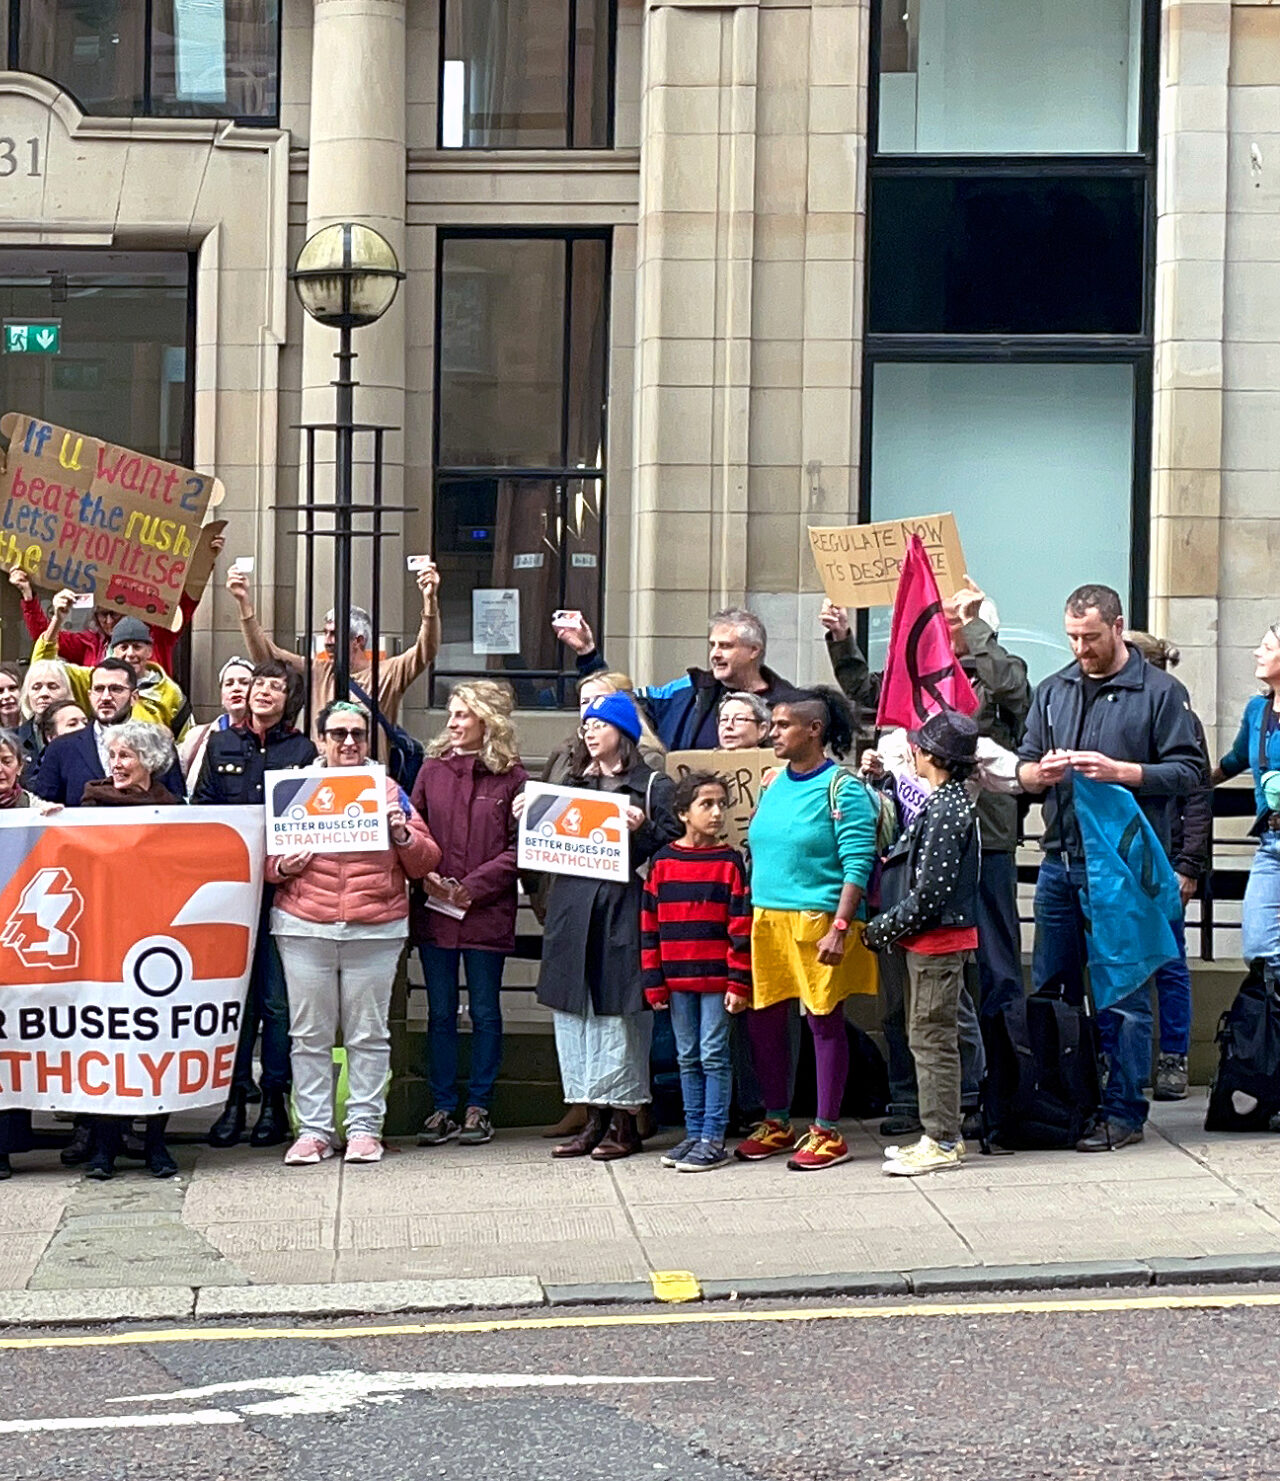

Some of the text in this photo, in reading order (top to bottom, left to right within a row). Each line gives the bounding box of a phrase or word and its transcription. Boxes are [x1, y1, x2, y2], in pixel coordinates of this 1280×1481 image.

[23, 420, 53, 457] If
[179, 477, 205, 513] 2
[10, 466, 192, 558] beat the rush
[811, 520, 943, 553] REGULATE NOW
[45, 550, 100, 593] bus
[849, 552, 946, 582] DESPETE
[274, 819, 379, 832] BETTER BUSES FOR
[274, 831, 380, 846] STRATHCLYDE
[524, 836, 621, 857] BETTER BUSES FOR
[524, 848, 621, 872] STRATHCLYDE
[19, 1005, 160, 1041] BUSES
[171, 1001, 241, 1040] FOR
